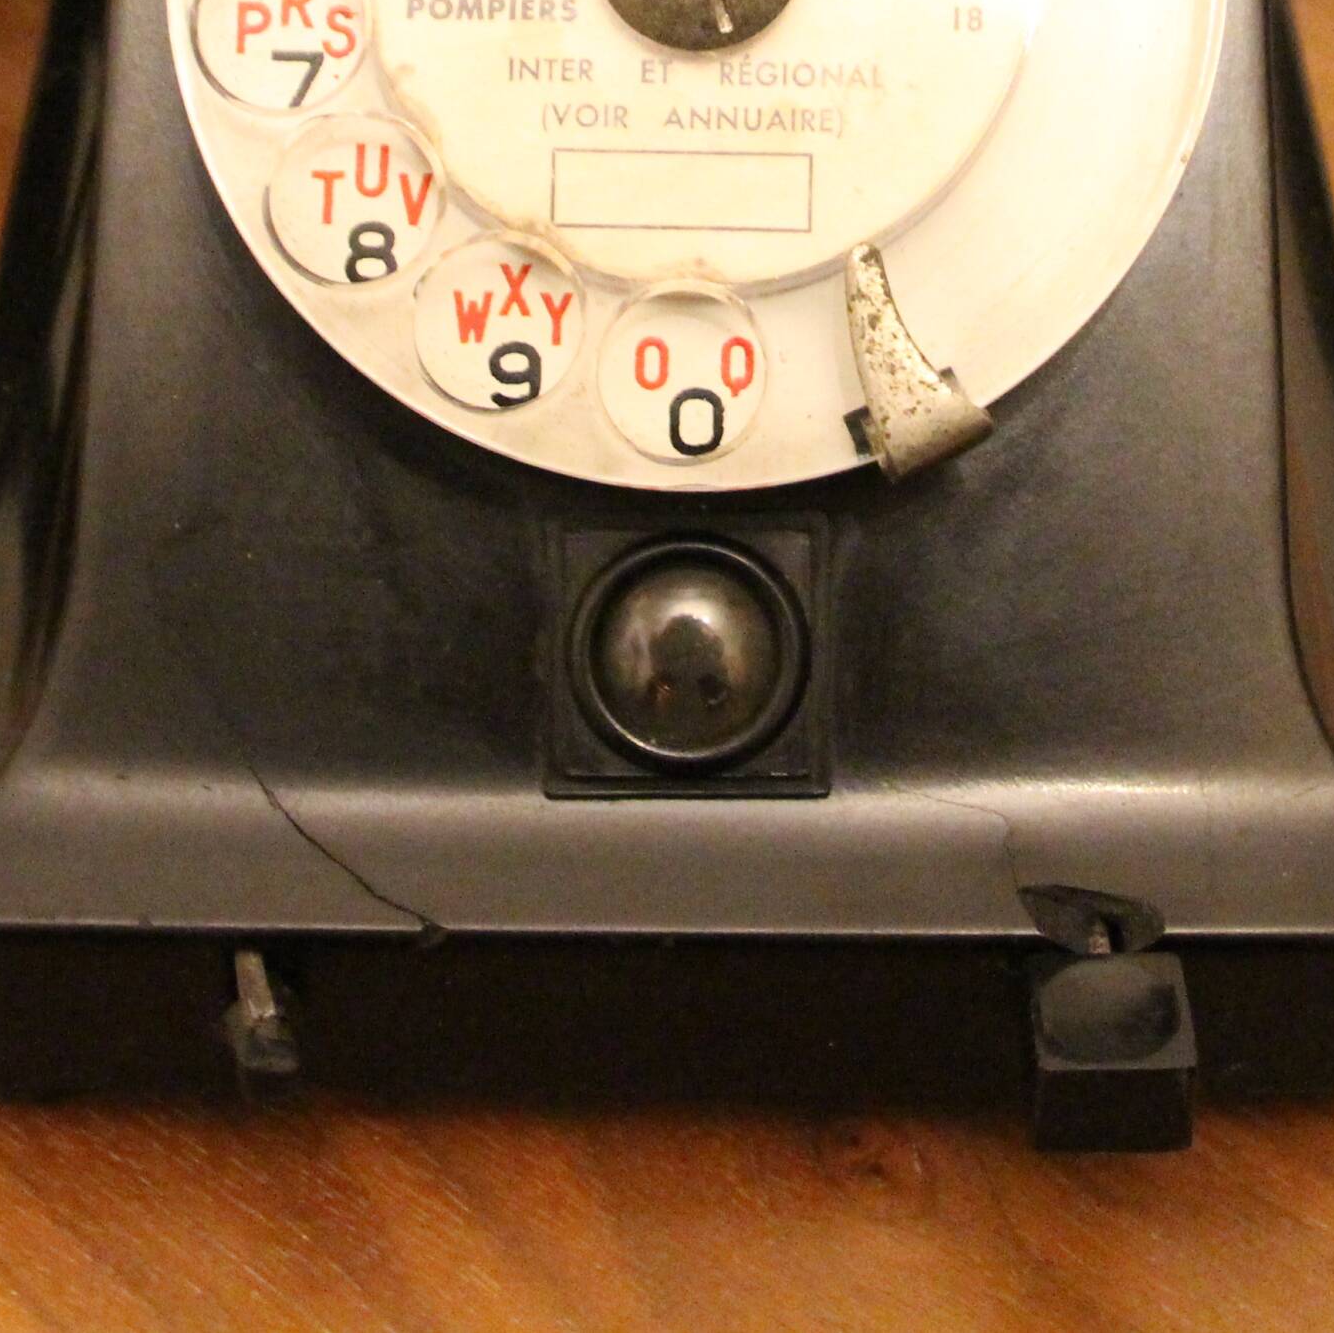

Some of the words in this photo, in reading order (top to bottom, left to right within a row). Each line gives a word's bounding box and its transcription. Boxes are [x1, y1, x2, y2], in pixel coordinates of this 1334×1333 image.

[953, 5, 984, 33] 18
[271, 51, 324, 108] 7
[507, 57, 594, 84] INTER
[640, 57, 673, 84] ET
[719, 51, 885, 90] RÉGIONAL
[541, 102, 629, 133] (VOIR
[663, 105, 845, 139] ANNUAIRE)
[311, 143, 433, 226] TUV
[345, 221, 398, 284] 8
[453, 263, 574, 345] WXY
[488, 341, 542, 408] 9
